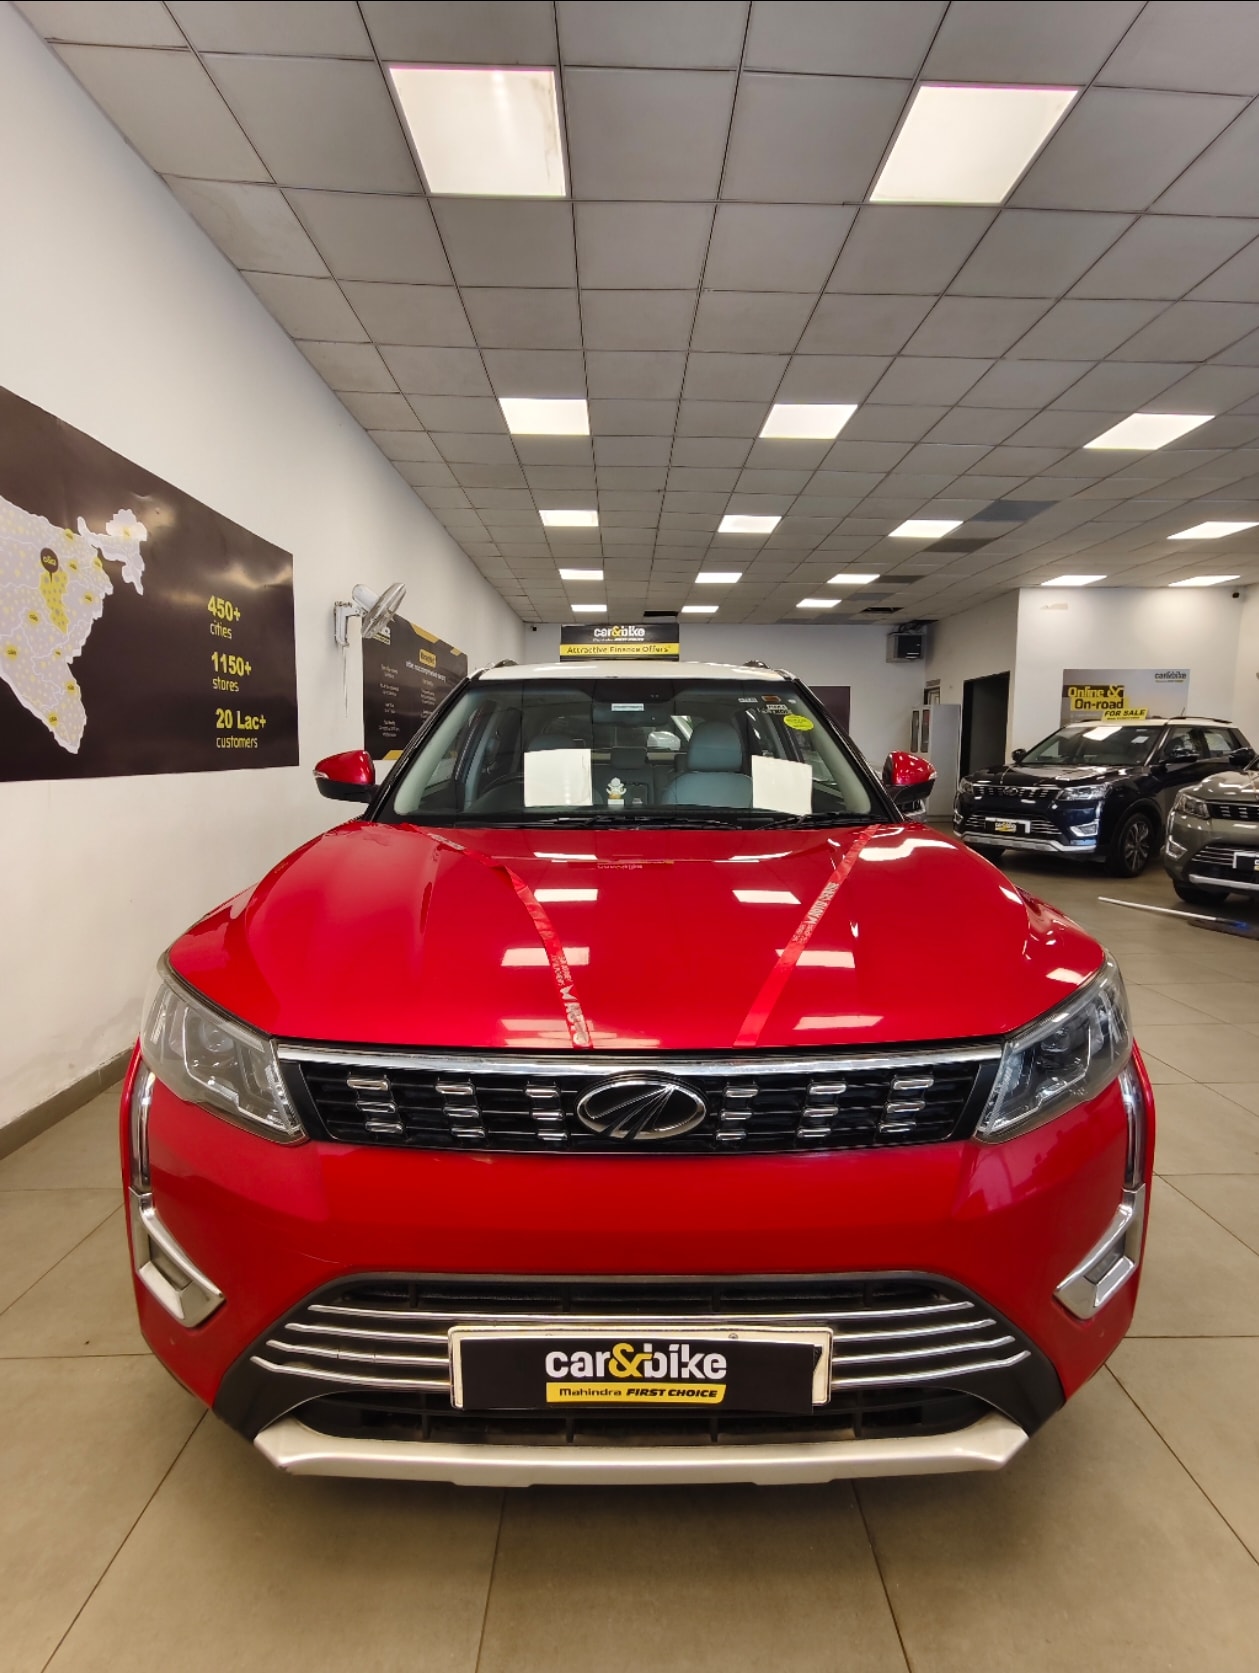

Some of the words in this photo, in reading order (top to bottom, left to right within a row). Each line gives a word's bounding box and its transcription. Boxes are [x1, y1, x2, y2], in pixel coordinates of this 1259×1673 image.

[207, 595, 241, 622] 450+
[210, 620, 233, 639] cities
[211, 651, 252, 677] 1150+
[212, 676, 240, 692] stores
[1068, 686, 1105, 698] Online
[1075, 698, 1124, 710] On-road
[215, 708, 233, 729] 20
[236, 710, 266, 730] Lac+
[1123, 709, 1147, 717] SALE
[216, 736, 258, 749] customers
[545, 1342, 727, 1380] car&bike
[559, 1388, 622, 1397] Mahindra
[626, 1388, 666, 1397] FIRST
[667, 1389, 718, 1398] CHOICE
